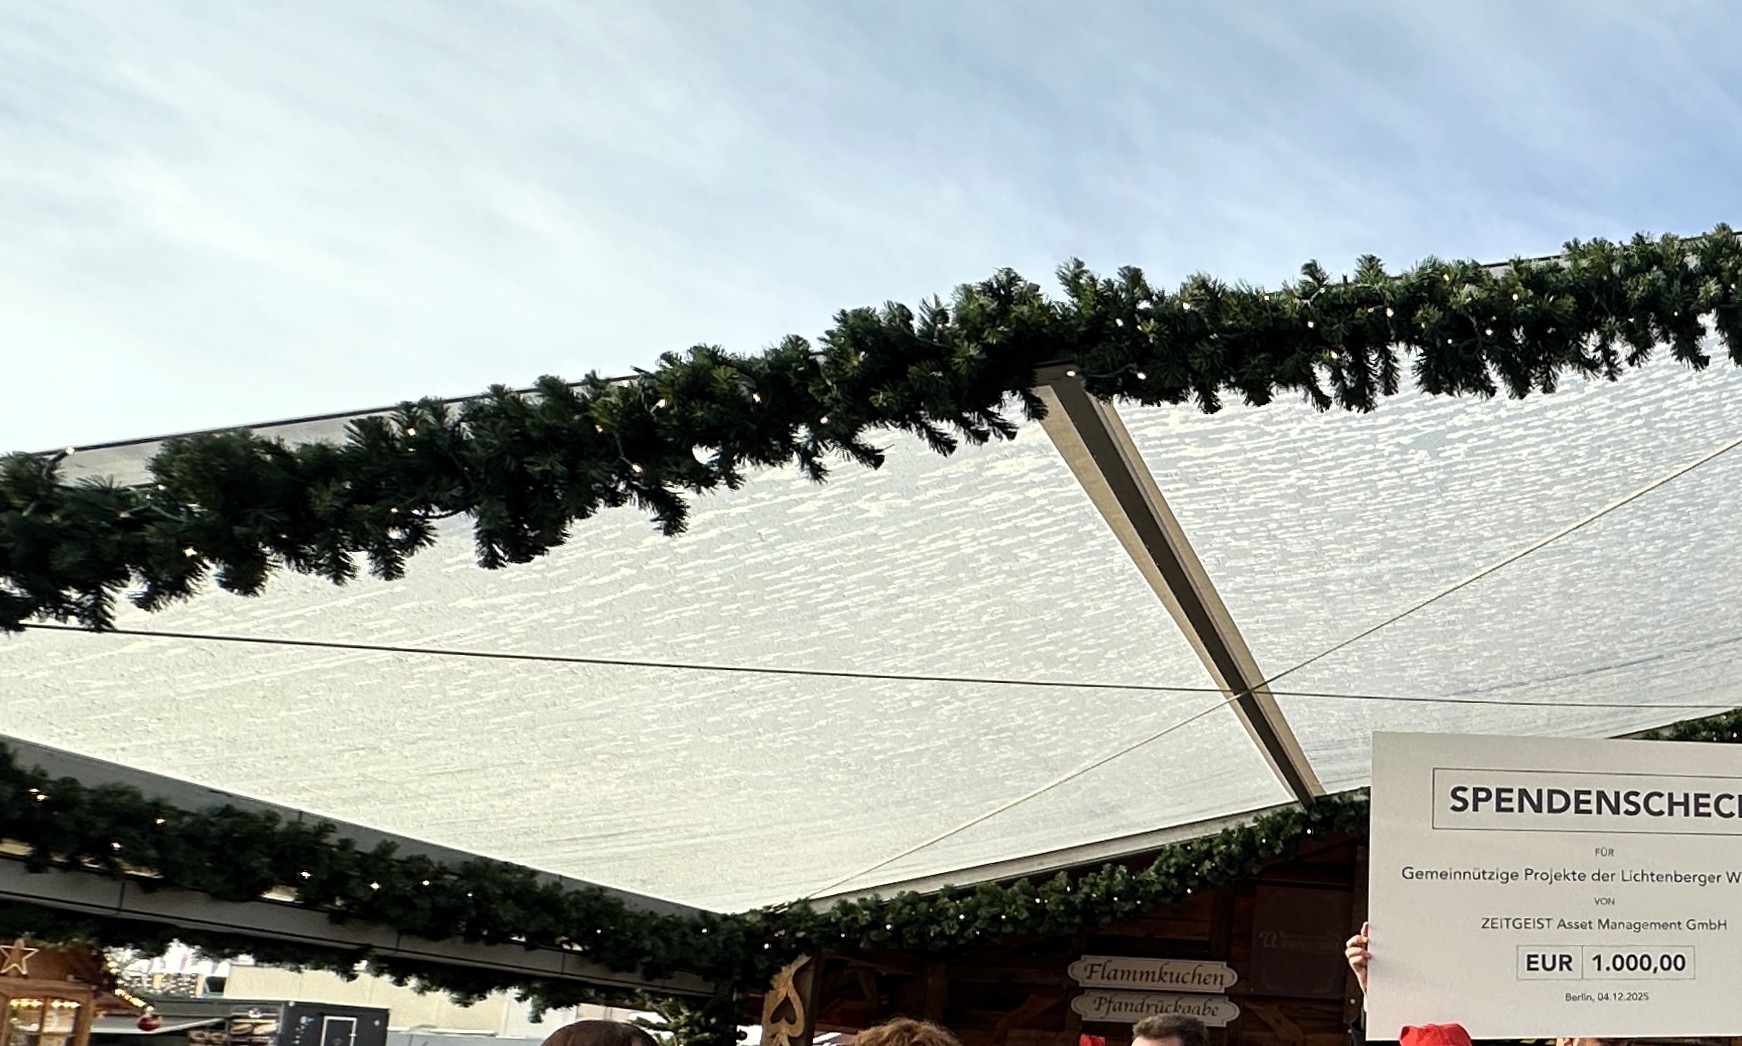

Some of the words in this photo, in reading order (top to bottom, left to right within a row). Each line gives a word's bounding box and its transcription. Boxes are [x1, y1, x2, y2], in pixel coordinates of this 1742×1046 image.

[1595, 847, 1615, 857] FÜR
[1401, 866, 1519, 883] Gemeinnützige
[1524, 868, 1587, 884] Projekte
[1591, 868, 1616, 883] der
[1621, 869, 1722, 886] Lichtenberger
[1594, 897, 1615, 906] VON
[1481, 917, 1552, 931] ZEITGEIST
[1557, 918, 1593, 931] Asset
[1597, 918, 1682, 933] Management
[1686, 918, 1727, 931] GmbH
[1526, 954, 1573, 971] EUR
[1592, 954, 1686, 975] 1.000,00
[1084, 960, 1224, 987] Flammkuchen
[1565, 992, 1595, 1002] Berlin,
